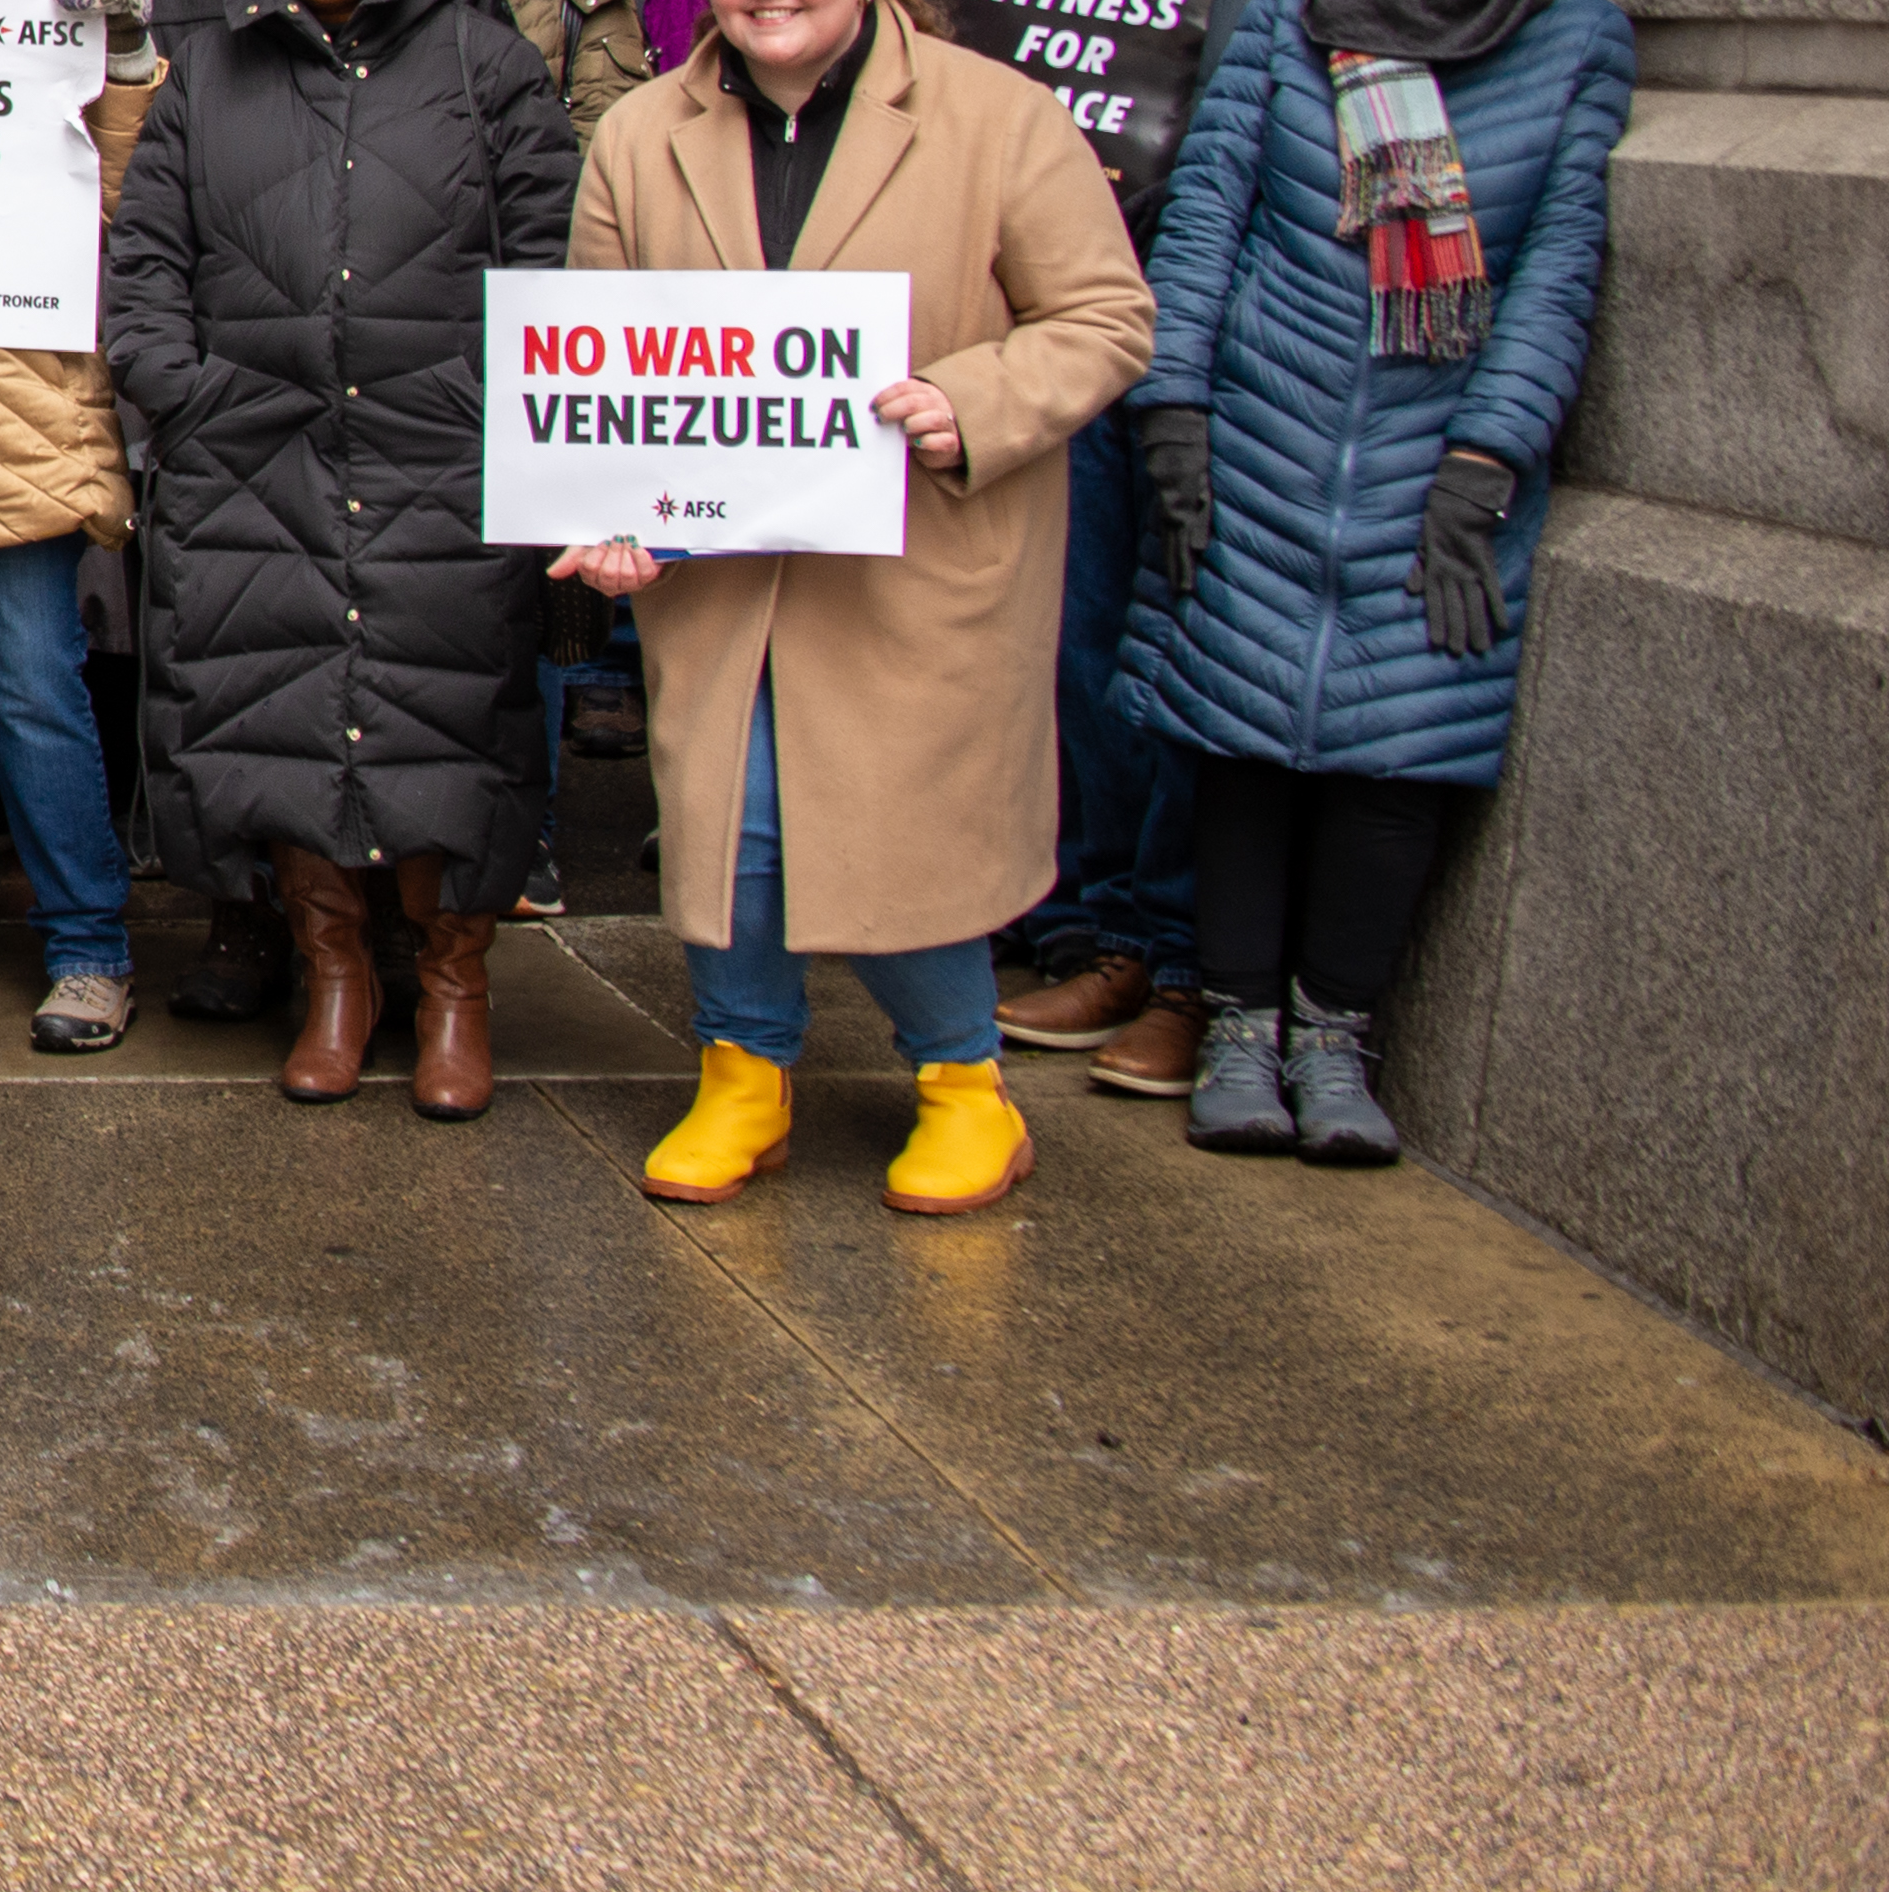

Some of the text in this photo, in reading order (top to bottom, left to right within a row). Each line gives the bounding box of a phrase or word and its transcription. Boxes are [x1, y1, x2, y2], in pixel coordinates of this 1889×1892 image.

[17, 20, 85, 48] AFSC
[1014, 24, 1117, 76] FOR
[523, 325, 861, 379] NO WAR ON
[522, 392, 861, 449] VENEZUELA
[683, 500, 726, 519] AFSC
